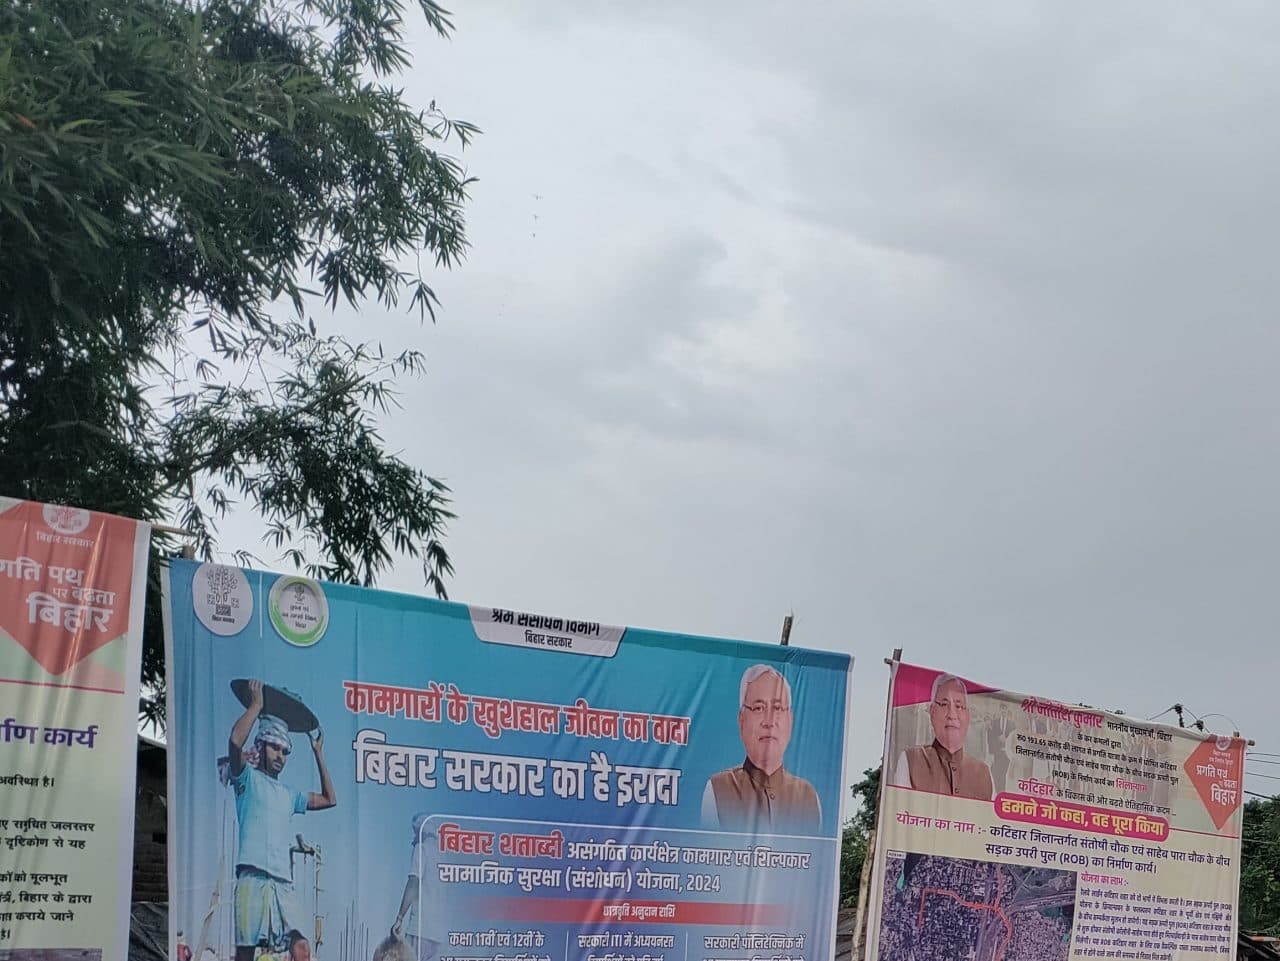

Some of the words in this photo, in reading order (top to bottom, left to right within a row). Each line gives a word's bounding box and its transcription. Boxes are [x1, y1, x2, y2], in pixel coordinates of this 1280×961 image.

[48, 565, 85, 586] पथ
[53, 587, 68, 598] पर
[26, 591, 113, 633] बिहार
[525, 630, 545, 644] बिहार
[546, 635, 573, 648] सरकार
[343, 680, 446, 723] कामगारों
[446, 683, 470, 724] के
[471, 696, 560, 739] खुशहाल
[563, 698, 619, 740] जीवन
[623, 712, 649, 743] का
[652, 714, 691, 746] वादा
[1073, 710, 1104, 728] कुमार
[44, 725, 98, 748] कार्य
[352, 728, 440, 789] बिहार
[442, 749, 547, 797] सरकार
[550, 758, 588, 800] का
[590, 752, 612, 803] है
[615, 765, 682, 807] इरादा
[1018, 778, 1054, 796] कटिहार
[1211, 783, 1237, 806] बिहार
[1000, 799, 1037, 817] हमने
[1040, 801, 1058, 821] जो
[1060, 808, 1088, 828] कहा,
[1091, 813, 1109, 828] वह
[1111, 815, 1133, 835] पूरा
[1136, 815, 1165, 836] किया
[53, 836, 64, 848] से
[68, 839, 86, 850] यह
[438, 824, 495, 856] बिहार
[499, 829, 564, 860] शताब्दी
[567, 838, 627, 861] असंगठित
[630, 841, 679, 864] कार्यक्षेत्र
[683, 848, 732, 866] कामगार
[735, 846, 752, 866] एवं
[753, 846, 811, 870] शिल्पकार
[896, 811, 932, 828] योजना
[934, 818, 951, 832] का
[953, 821, 975, 834] नाम
[990, 825, 1027, 842] कटिहार
[1030, 828, 1078, 848] जिलान्तर्गत
[1080, 837, 1108, 852] संतोषी
[1110, 839, 1129, 854] चौक
[1132, 844, 1144, 857] एवं
[1146, 845, 1168, 858] साहेब
[1170, 850, 1186, 862] पारा
[1187, 850, 1205, 863] चौक
[1206, 853, 1214, 865] के
[1216, 855, 1230, 867] बीच
[986, 843, 1013, 858] सड़क
[1015, 844, 1037, 859] उपरी
[1041, 849, 1057, 864] पुल
[1059, 852, 1089, 868] (ROB)
[1091, 856, 1104, 867] का
[1107, 855, 1133, 871] निर्माण
[13, 871, 26, 881] को
[30, 873, 68, 886] मूलभूत
[438, 861, 515, 885] सामाजिक
[517, 867, 562, 892] सुरक्षा
[565, 866, 632, 893] (संशोधन)
[636, 867, 684, 893] योजना,
[686, 873, 721, 892] 2024
[19, 890, 48, 903] बिहार
[53, 891, 64, 902] के
[68, 893, 92, 904] द्वारा
[50, 910, 74, 921] जाने
[449, 931, 473, 947] कक्षा
[534, 931, 545, 948] के
[578, 931, 609, 948] सरकारी
[611, 934, 622, 948] ITI
[624, 931, 634, 948] में
[633, 935, 675, 948] अध्ययनरत
[704, 934, 740, 949] सरकारी
[741, 931, 794, 950] पॉलिटेक्निक
[794, 932, 807, 950] में
